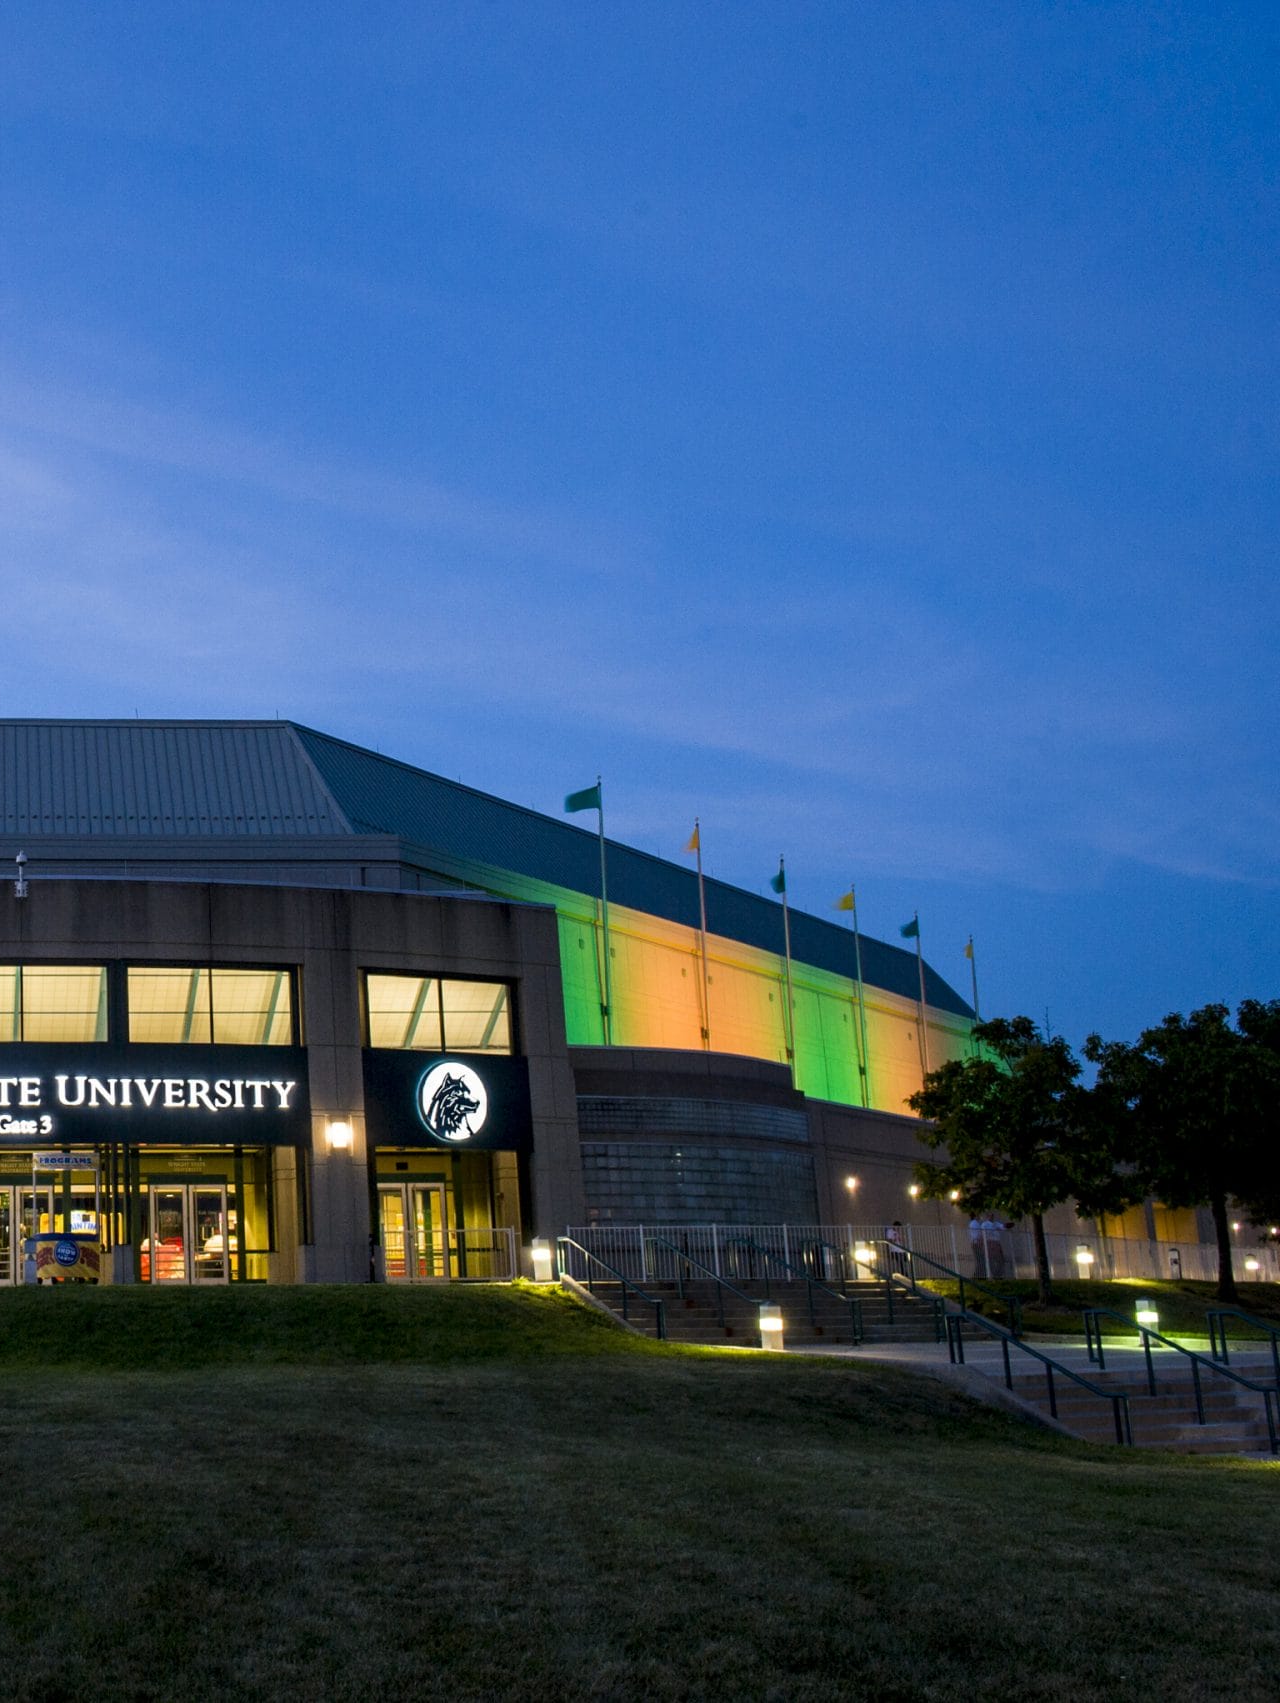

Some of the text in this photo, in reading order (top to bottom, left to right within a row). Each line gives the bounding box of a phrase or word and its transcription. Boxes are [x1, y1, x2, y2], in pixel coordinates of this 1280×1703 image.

[54, 1075, 296, 1112] UNIVERSITY
[39, 1115, 52, 1134] 3
[39, 1156, 92, 1165] PROGRAMS
